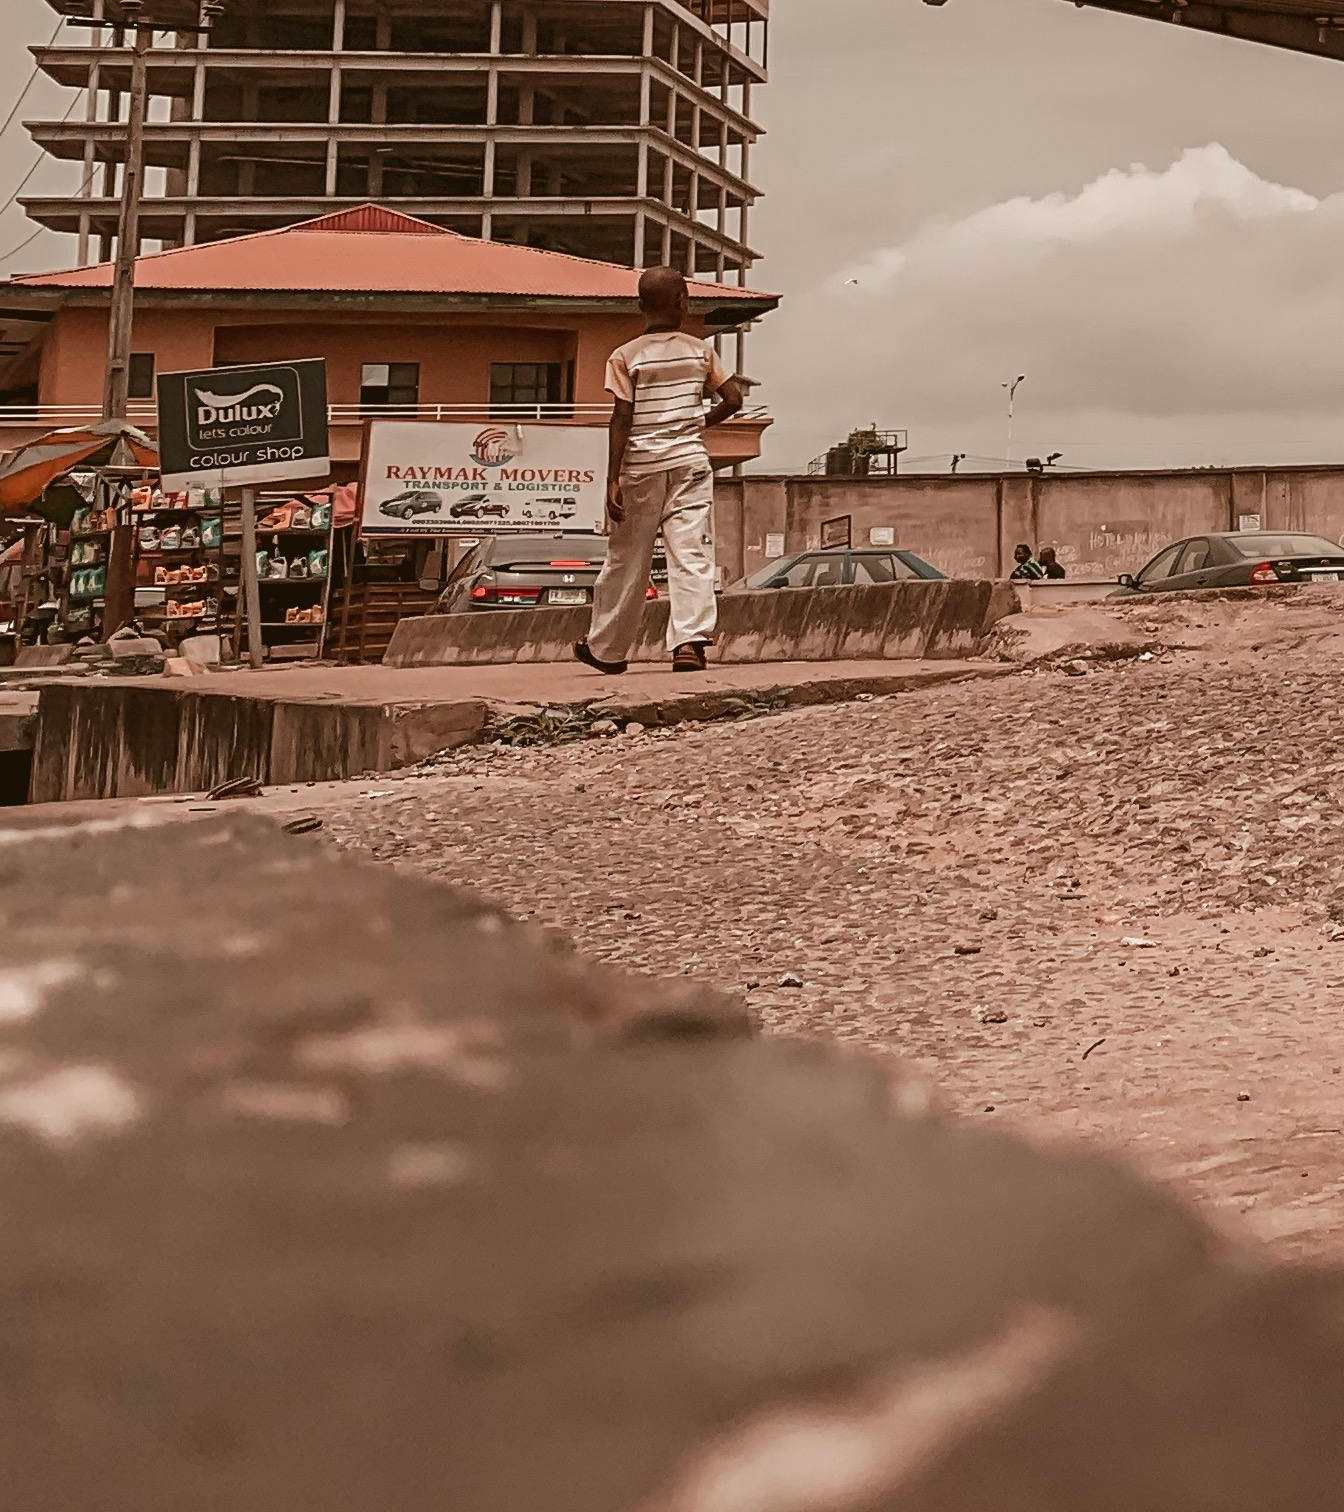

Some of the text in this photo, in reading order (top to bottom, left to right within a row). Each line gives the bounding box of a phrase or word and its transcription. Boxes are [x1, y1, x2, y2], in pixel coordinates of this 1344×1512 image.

[197, 403, 275, 425] Dulux
[199, 423, 273, 440] let's colour
[190, 446, 304, 468] colour shop
[385, 465, 595, 483] RAYMAK MOVERS
[403, 480, 581, 493] TRANSPORT & LOGISTICS
